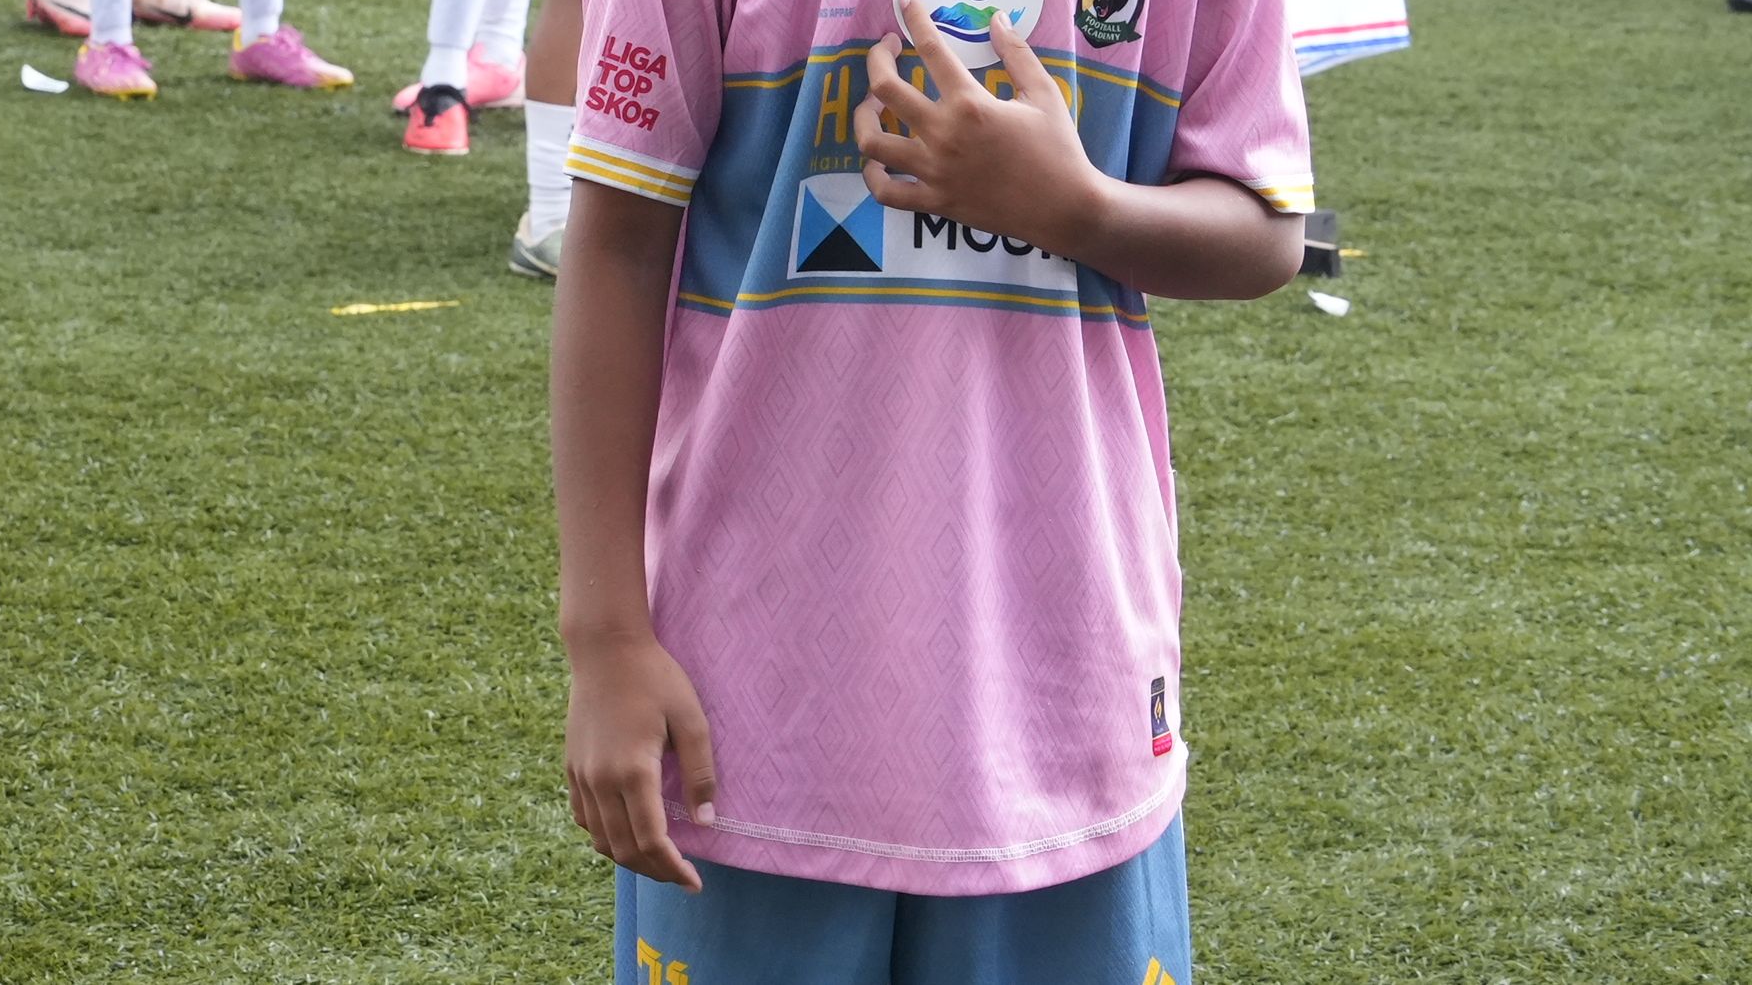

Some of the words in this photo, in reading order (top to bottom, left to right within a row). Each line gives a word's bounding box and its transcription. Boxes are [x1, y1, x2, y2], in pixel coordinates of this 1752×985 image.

[1081, 24, 1121, 41] ACADEMY
[1085, 15, 1122, 32] FOOTBALL
[601, 35, 667, 81] LIGA
[597, 59, 653, 98] TOP
